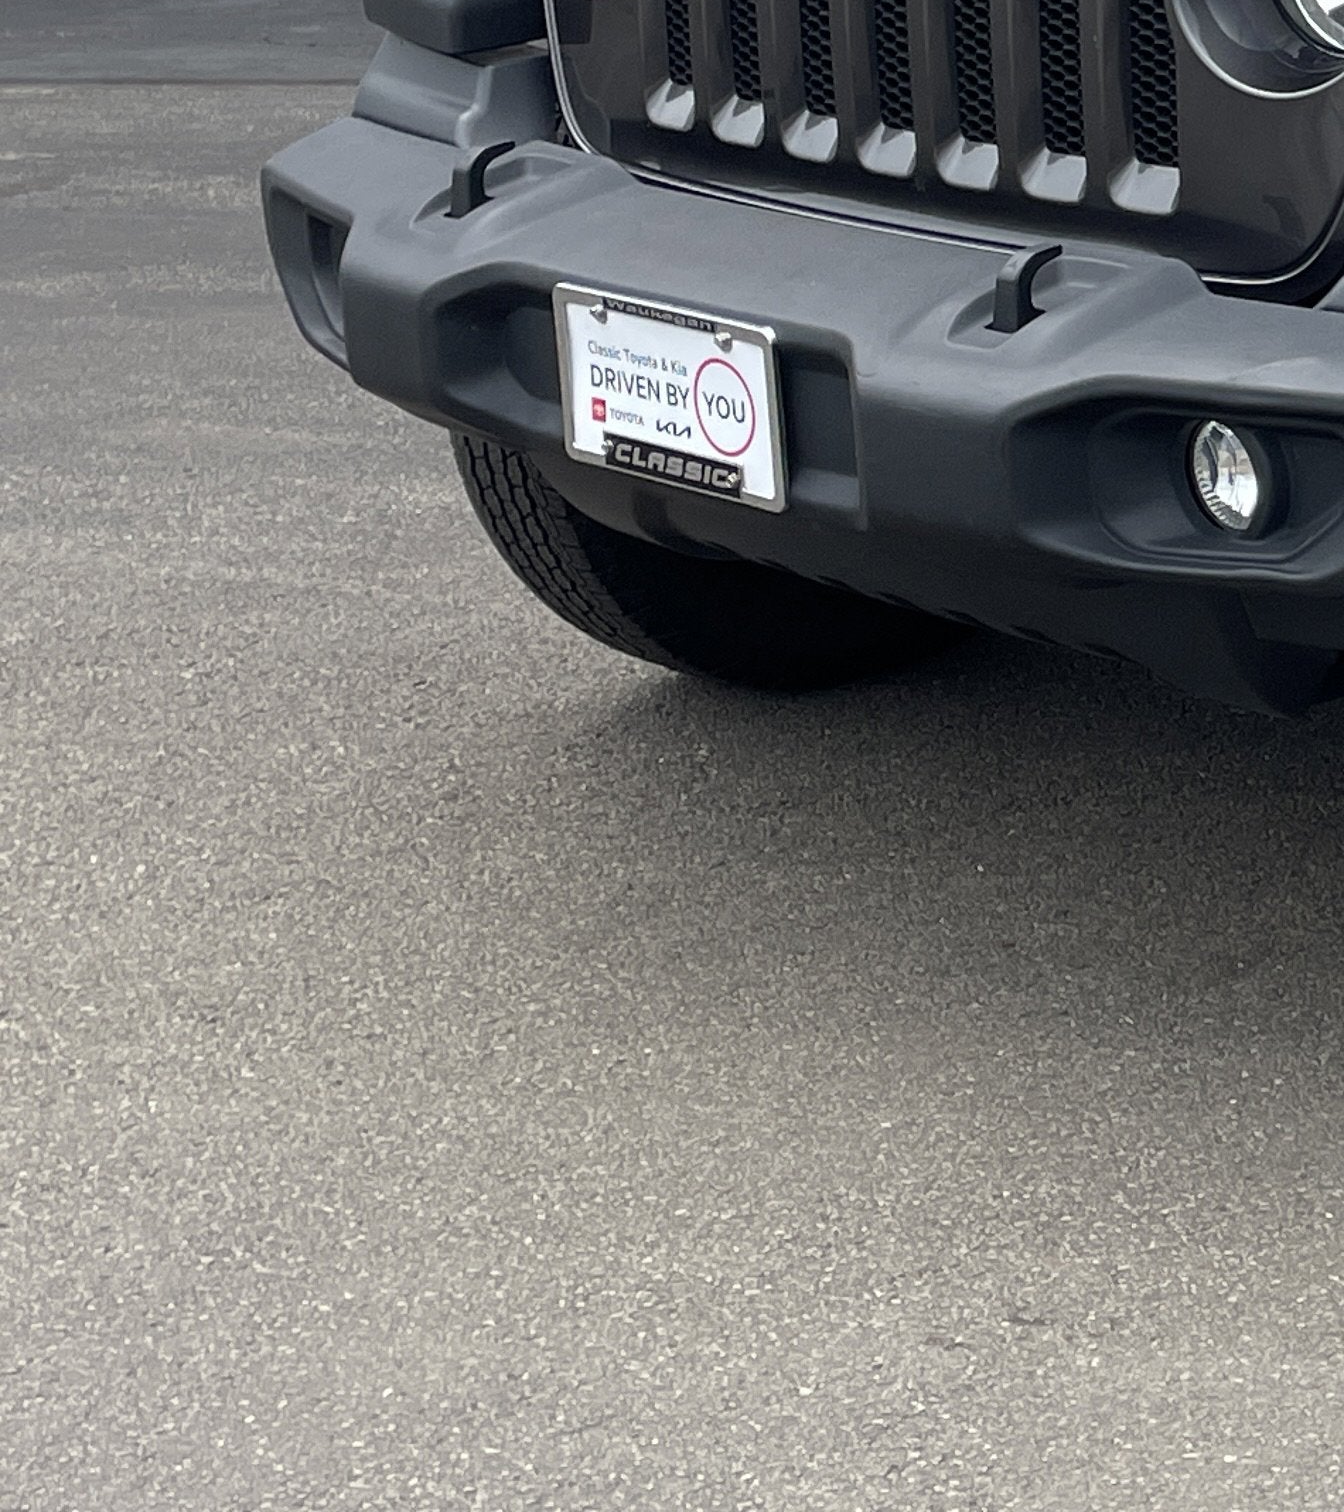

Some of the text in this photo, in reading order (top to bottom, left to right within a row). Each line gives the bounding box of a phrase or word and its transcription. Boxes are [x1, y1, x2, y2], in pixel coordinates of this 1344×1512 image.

[606, 298, 713, 332] Waukegan
[587, 340, 687, 377] Classic Toyota & Kia
[590, 364, 745, 423] DRIVEN BY YOU
[609, 407, 645, 426] TOYOTA
[615, 443, 731, 488] CLASSIC
